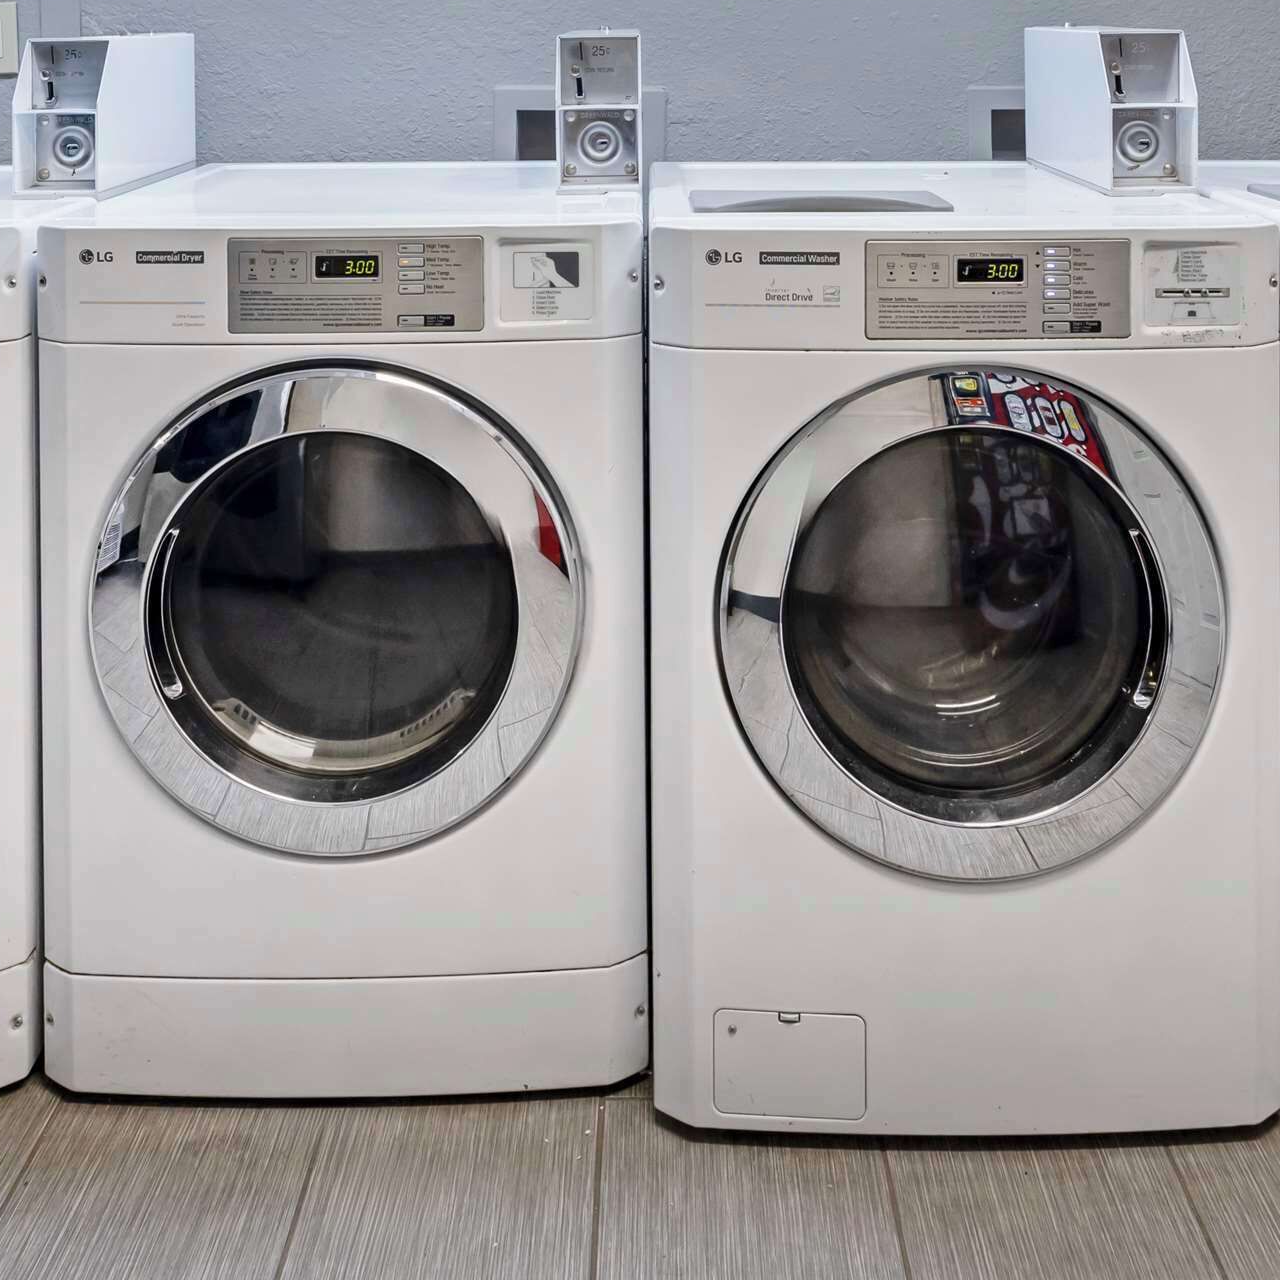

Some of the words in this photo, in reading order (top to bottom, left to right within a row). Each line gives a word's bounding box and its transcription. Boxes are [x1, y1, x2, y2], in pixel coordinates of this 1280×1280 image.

[96, 252, 114, 262] LG
[137, 253, 180, 262] Commercial
[181, 253, 203, 263] Dryer
[724, 252, 743, 263] LG
[761, 254, 806, 263] Commercial
[808, 254, 838, 263] Washer
[765, 292, 790, 301] Direct
[791, 292, 813, 302] Drive
